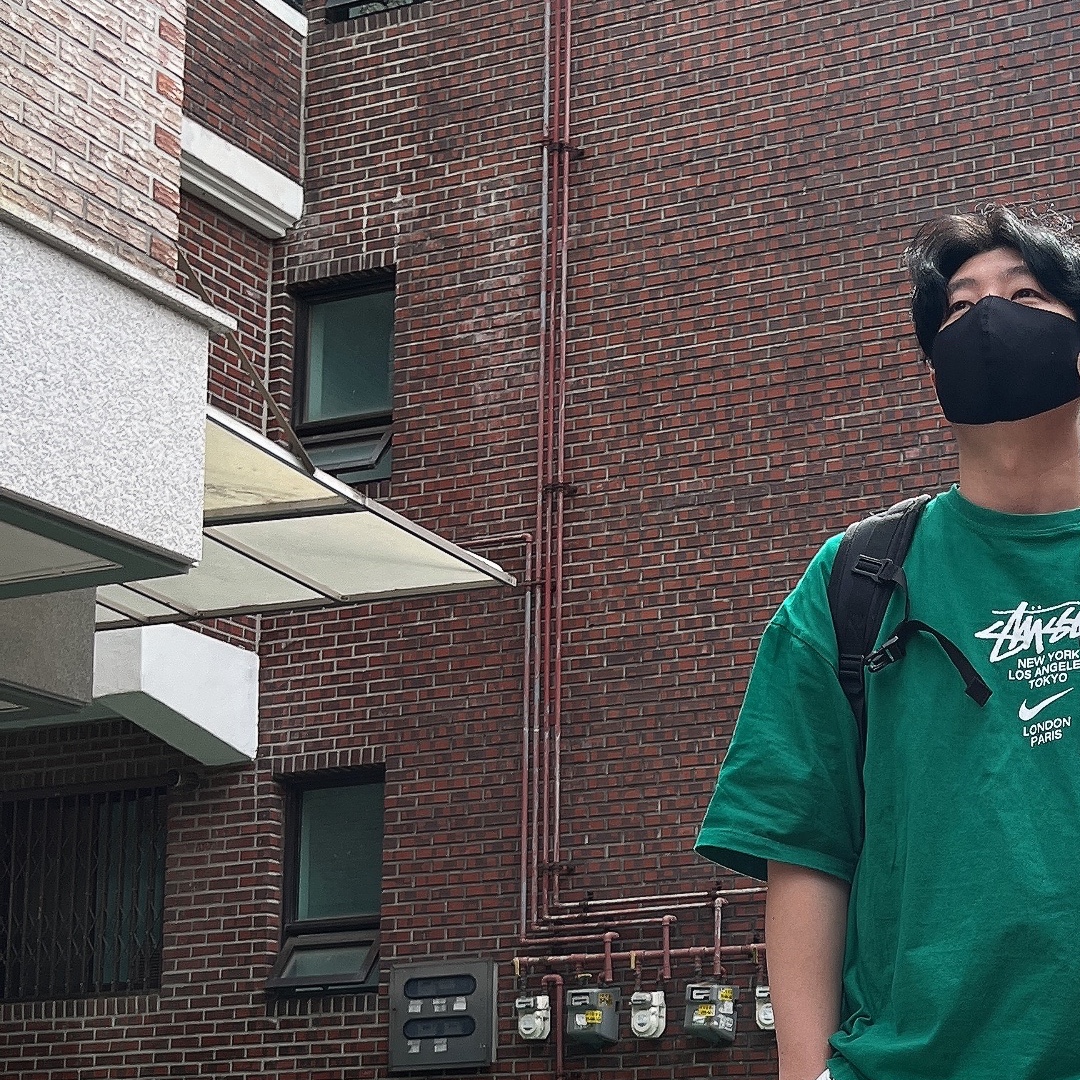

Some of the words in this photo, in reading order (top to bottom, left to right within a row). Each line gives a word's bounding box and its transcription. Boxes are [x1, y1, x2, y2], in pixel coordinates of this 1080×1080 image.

[1017, 655, 1046, 669] NEW
[1048, 649, 1080, 662] YORK
[1008, 669, 1032, 681] LOS
[1028, 672, 1068, 690] TOKYO
[1022, 715, 1072, 737] LONDON
[1030, 728, 1063, 748] PARIS
